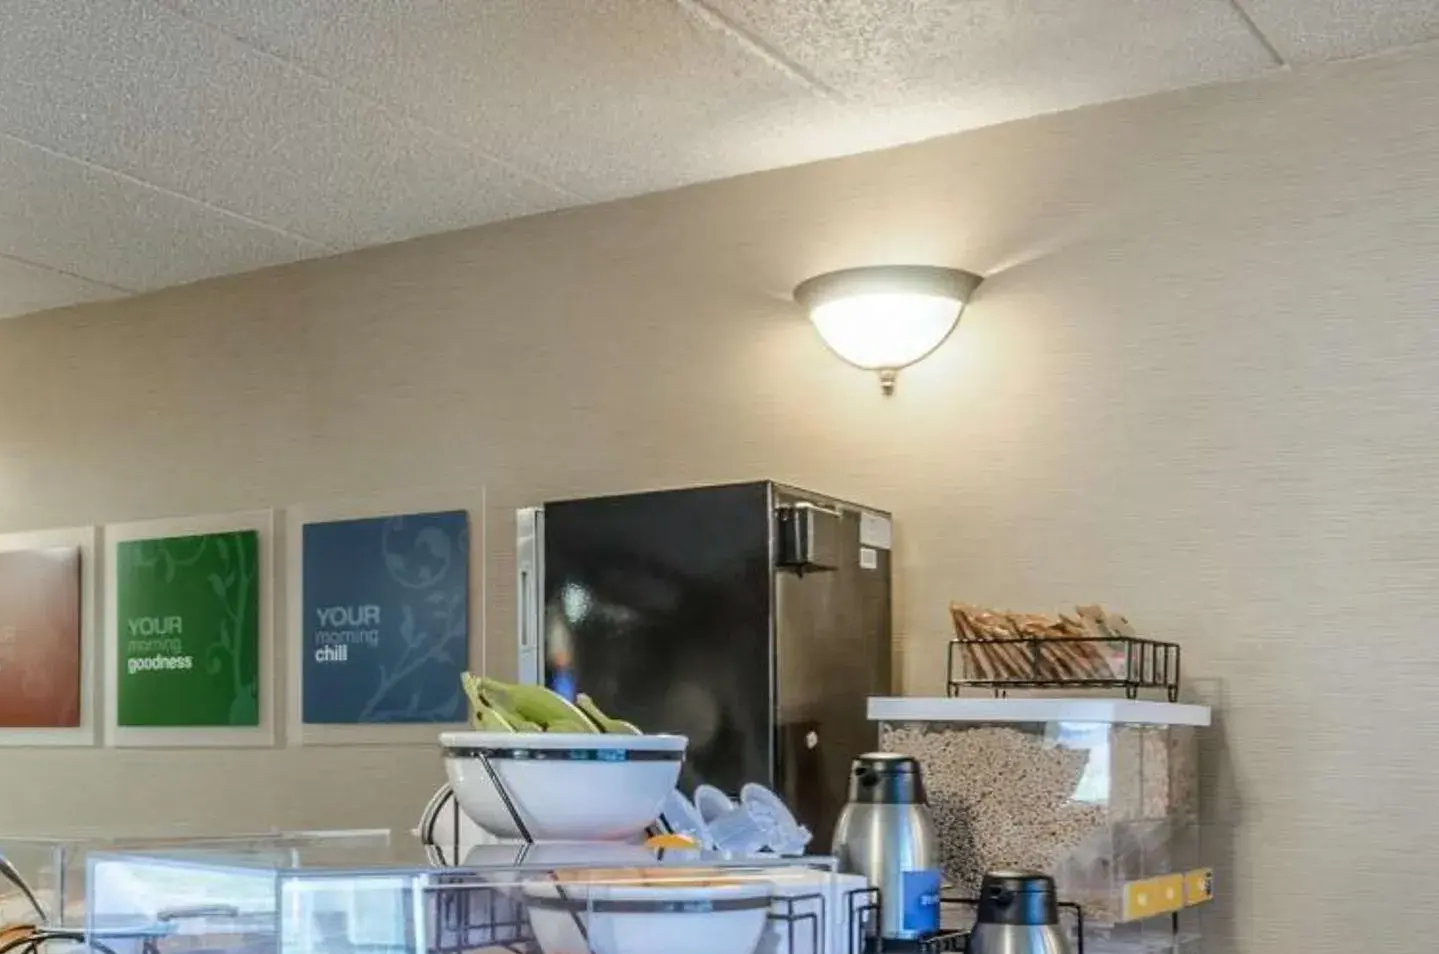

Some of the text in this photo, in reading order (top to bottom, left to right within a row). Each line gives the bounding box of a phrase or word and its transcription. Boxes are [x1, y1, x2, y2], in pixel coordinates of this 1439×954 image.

[128, 616, 182, 636] YOUR
[316, 605, 380, 627] YOUR
[315, 629, 379, 648] morning
[127, 653, 193, 674] goodness
[315, 644, 348, 663] chill
